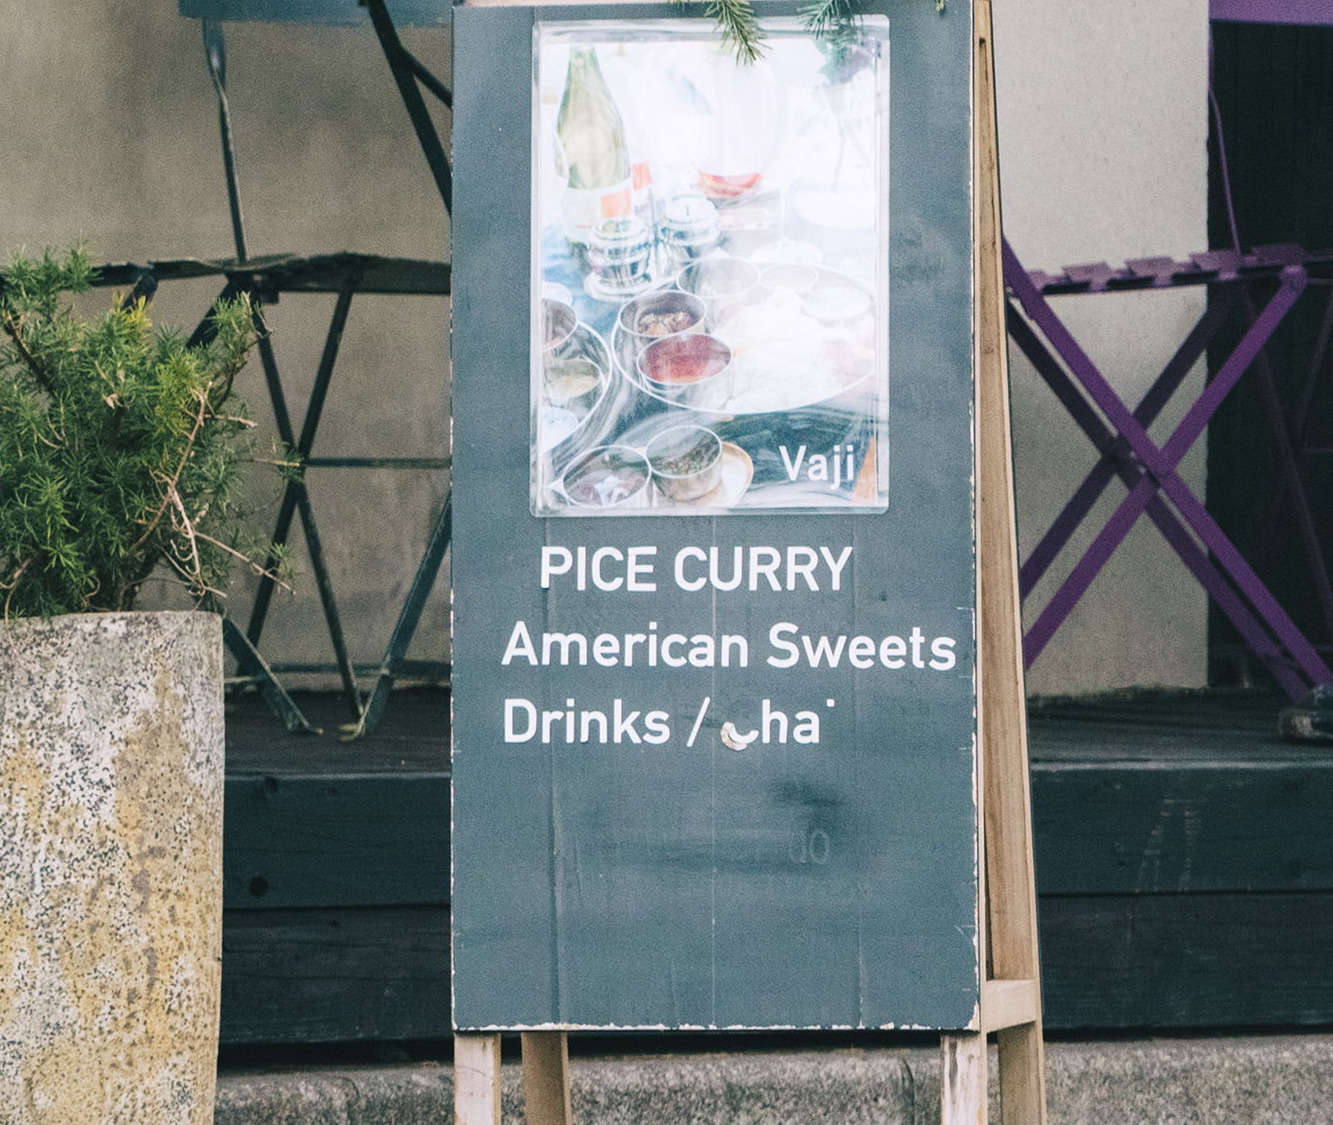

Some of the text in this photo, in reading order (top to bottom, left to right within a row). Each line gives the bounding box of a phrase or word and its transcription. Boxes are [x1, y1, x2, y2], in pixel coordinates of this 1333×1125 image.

[779, 445, 854, 490] Vaji
[540, 545, 853, 592] PICE CURRY
[501, 620, 956, 671] American Sweets
[504, 698, 671, 745] Drinks
[686, 697, 711, 747] /
